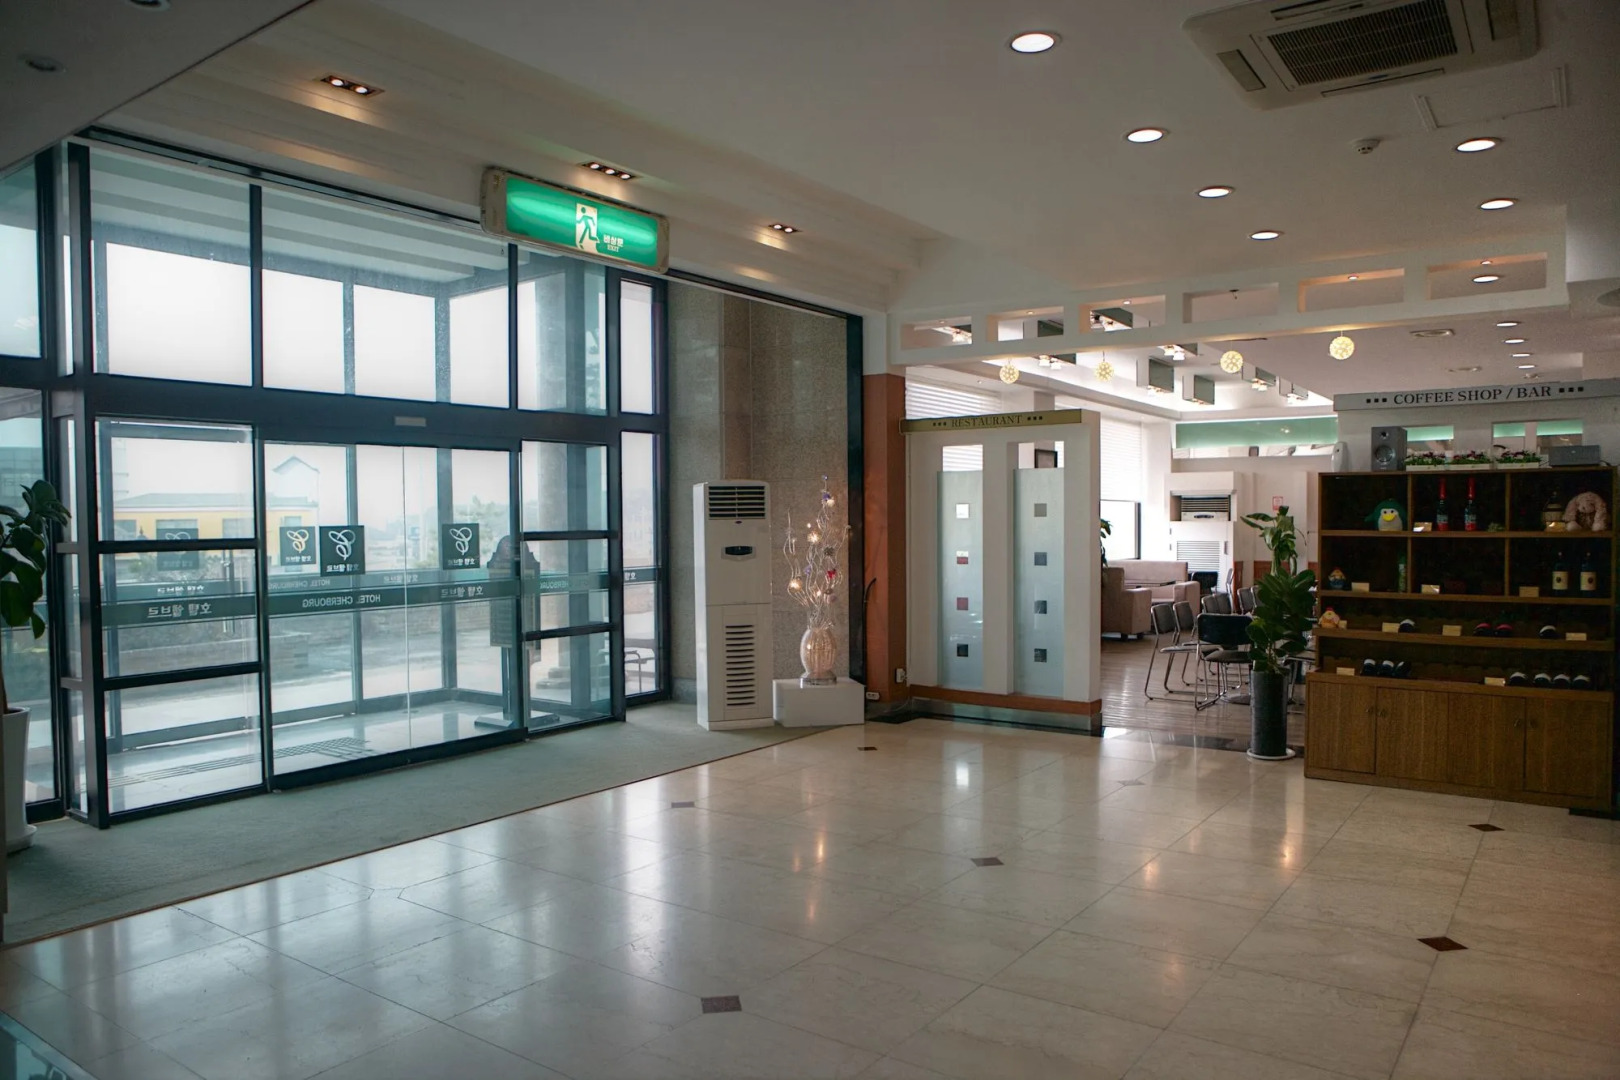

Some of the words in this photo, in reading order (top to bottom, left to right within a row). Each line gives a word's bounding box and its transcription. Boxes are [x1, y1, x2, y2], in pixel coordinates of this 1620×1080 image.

[604, 235, 623, 247] 비상문
[1393, 391, 1454, 405] COFFEE
[1458, 388, 1503, 402] SHOP
[1517, 386, 1552, 399] BAR
[952, 415, 1023, 428] RESTAURANT
